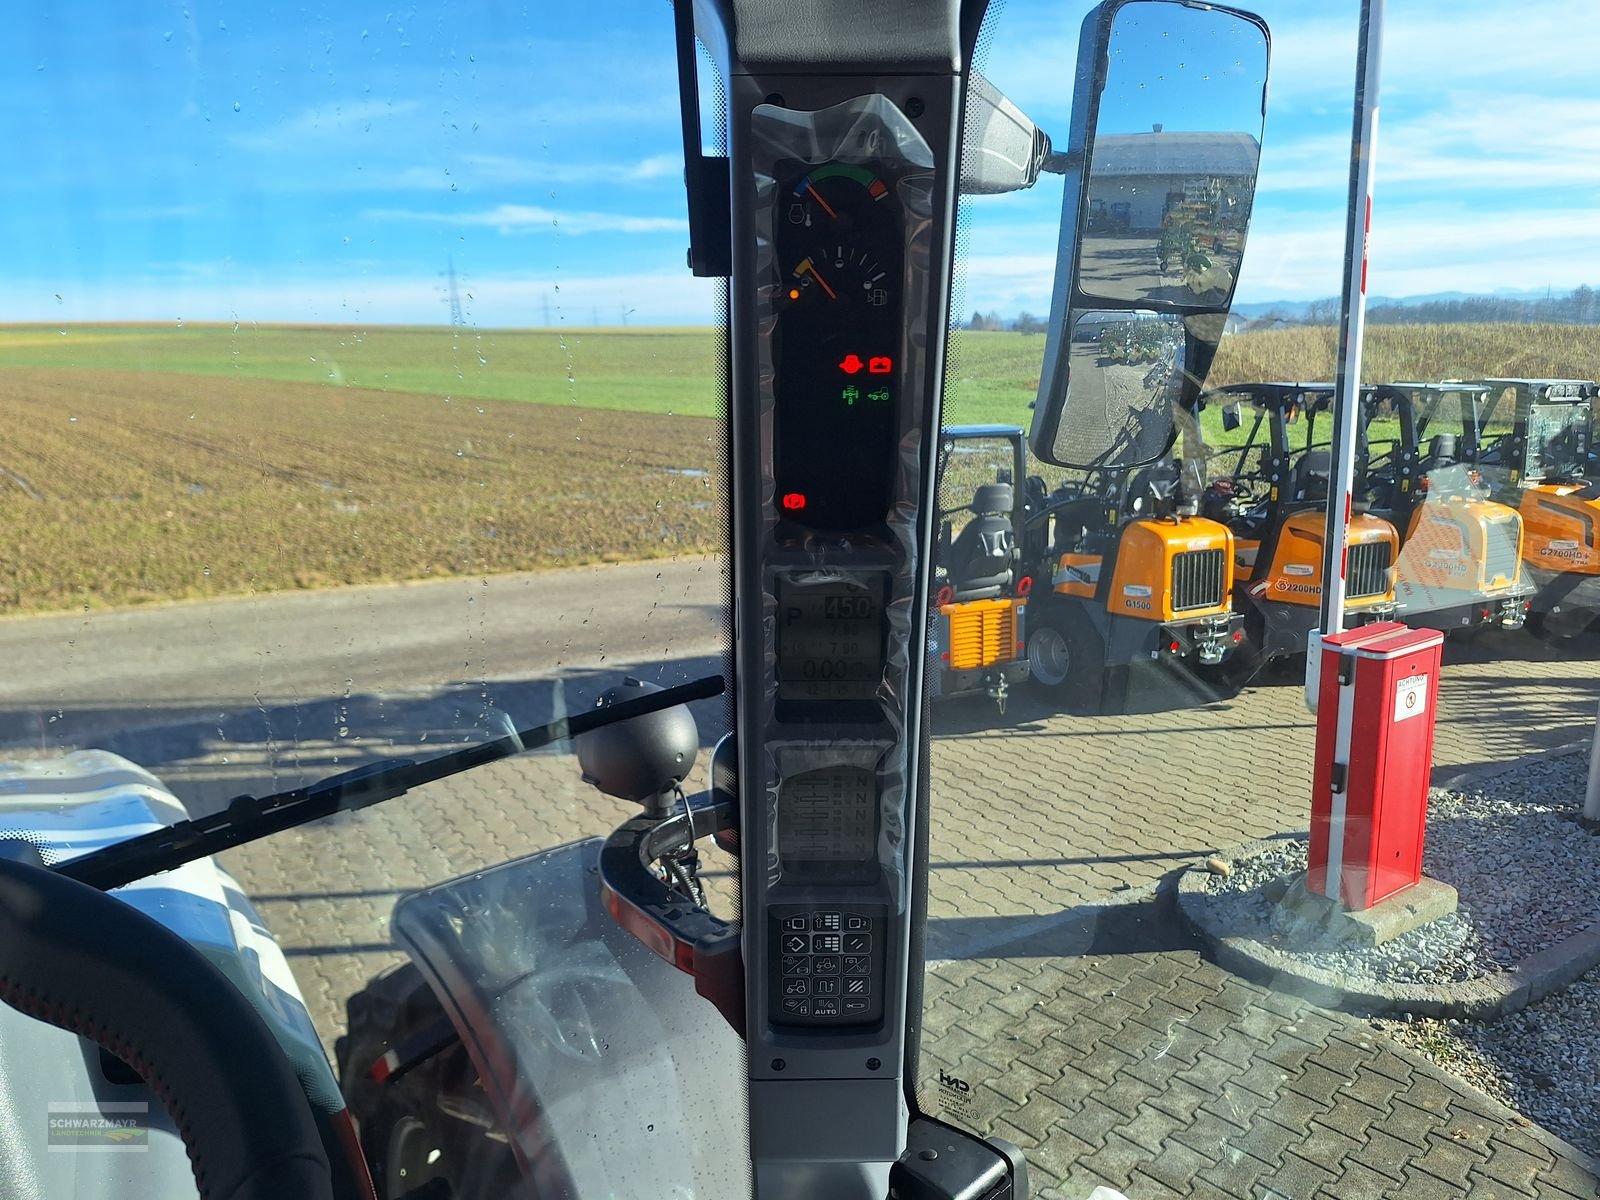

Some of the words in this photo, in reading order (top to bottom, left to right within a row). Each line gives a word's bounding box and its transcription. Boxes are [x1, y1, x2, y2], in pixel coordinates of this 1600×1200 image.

[828, 598, 870, 618] 450
[1125, 599, 1151, 610] G1500
[786, 608, 802, 627] P
